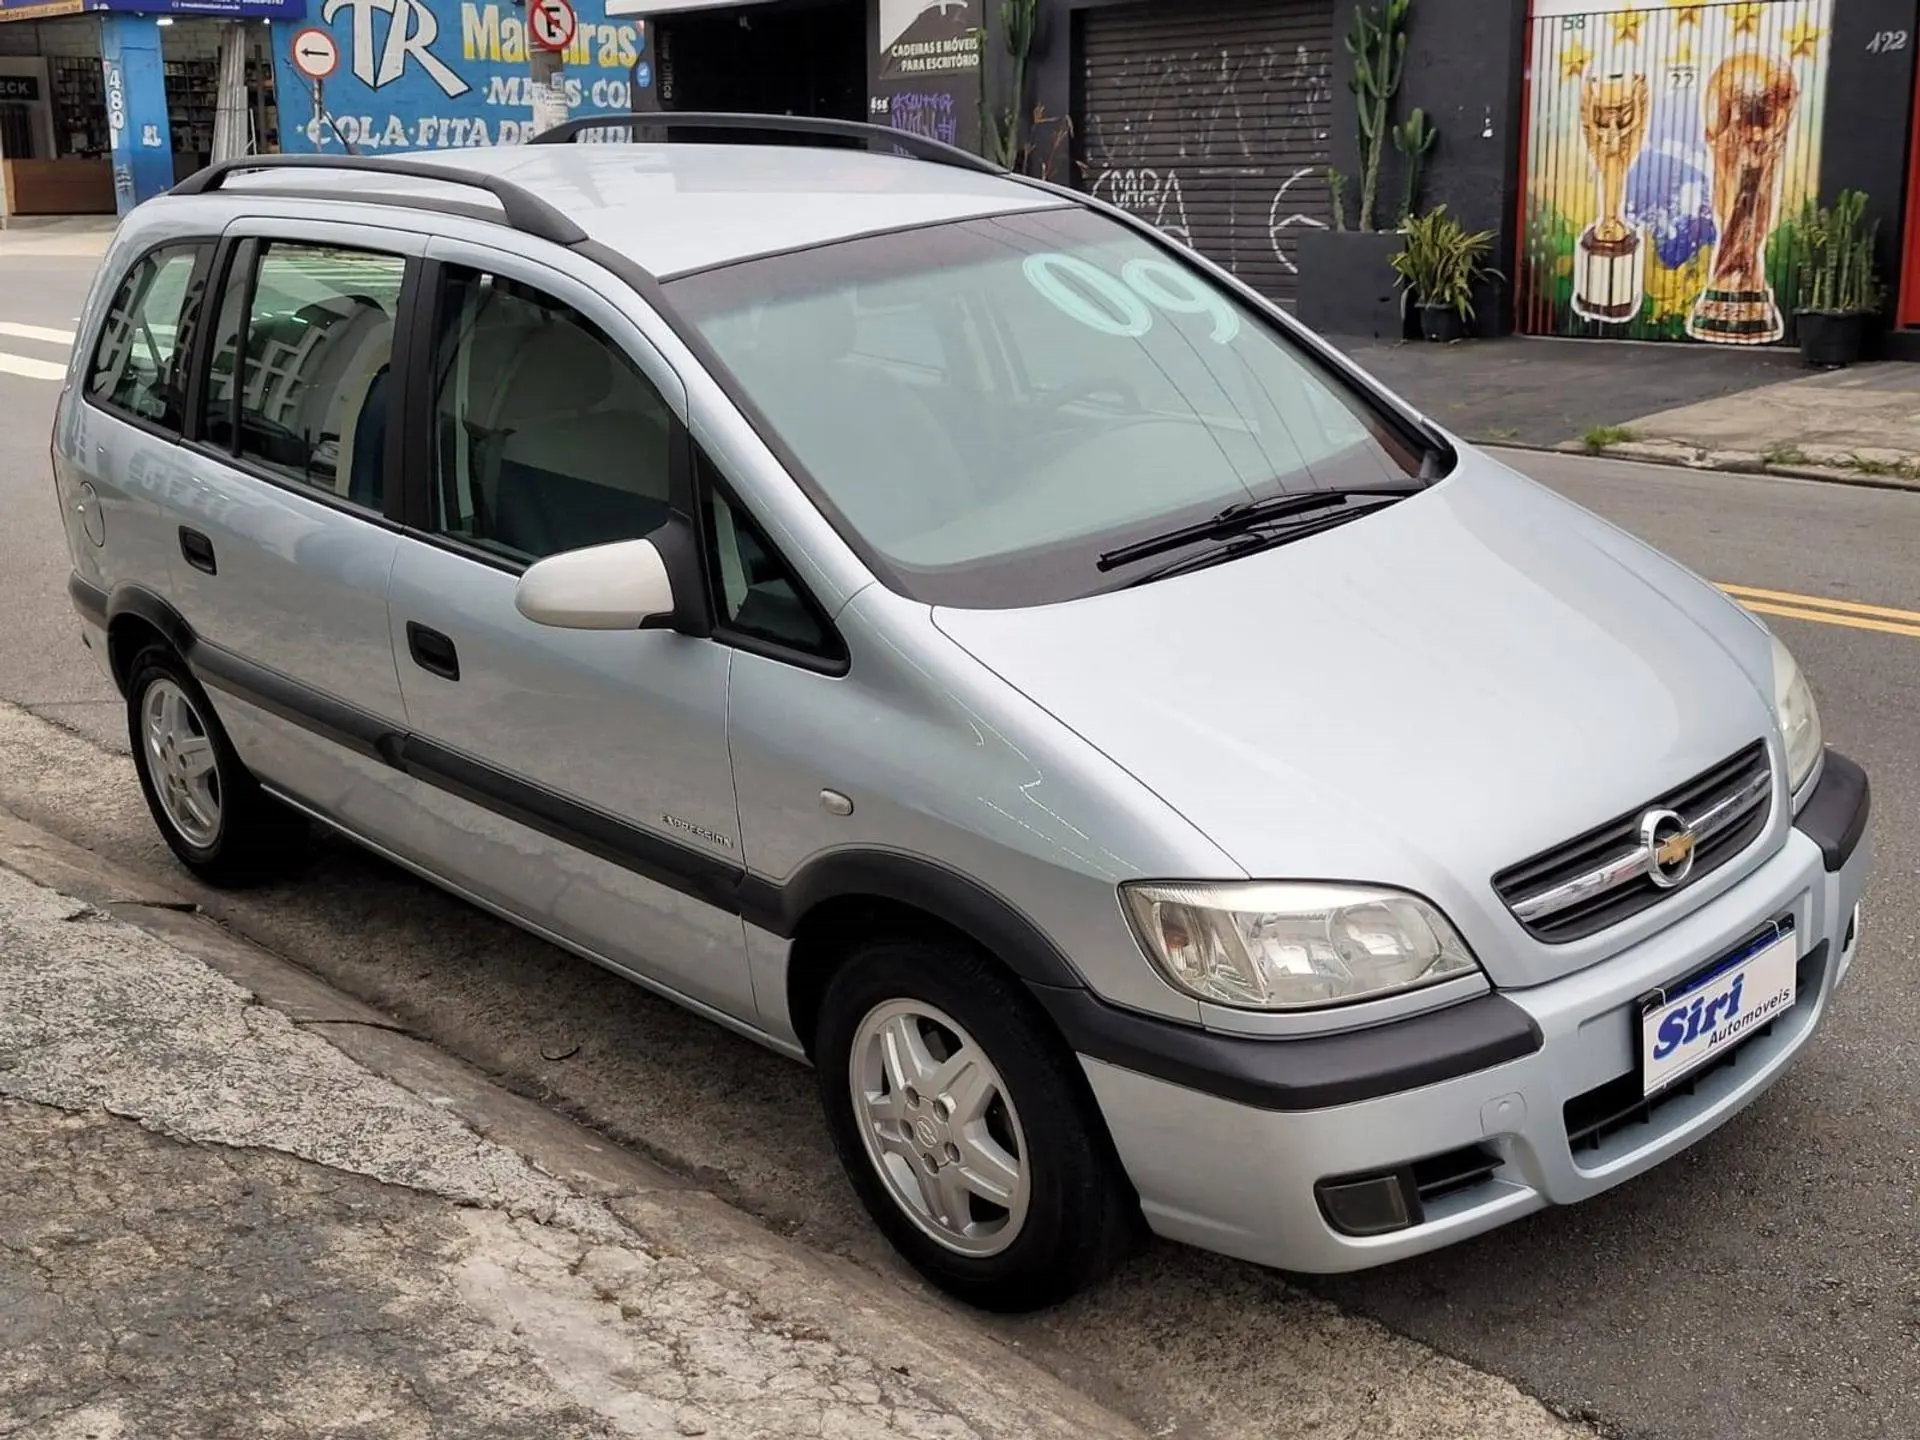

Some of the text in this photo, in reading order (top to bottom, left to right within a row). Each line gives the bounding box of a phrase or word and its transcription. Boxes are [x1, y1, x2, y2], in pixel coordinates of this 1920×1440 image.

[321, 0, 473, 98] TR
[891, 36, 979, 57] CADEIRAS E MÓVEIS
[1865, 30, 1908, 54] 122
[901, 53, 980, 71] PARA ESCRITÓRIO
[306, 112, 410, 149] COLA
[415, 115, 491, 148] FITA
[1022, 253, 1240, 344] 09
[1653, 972, 1745, 1060] Siri
